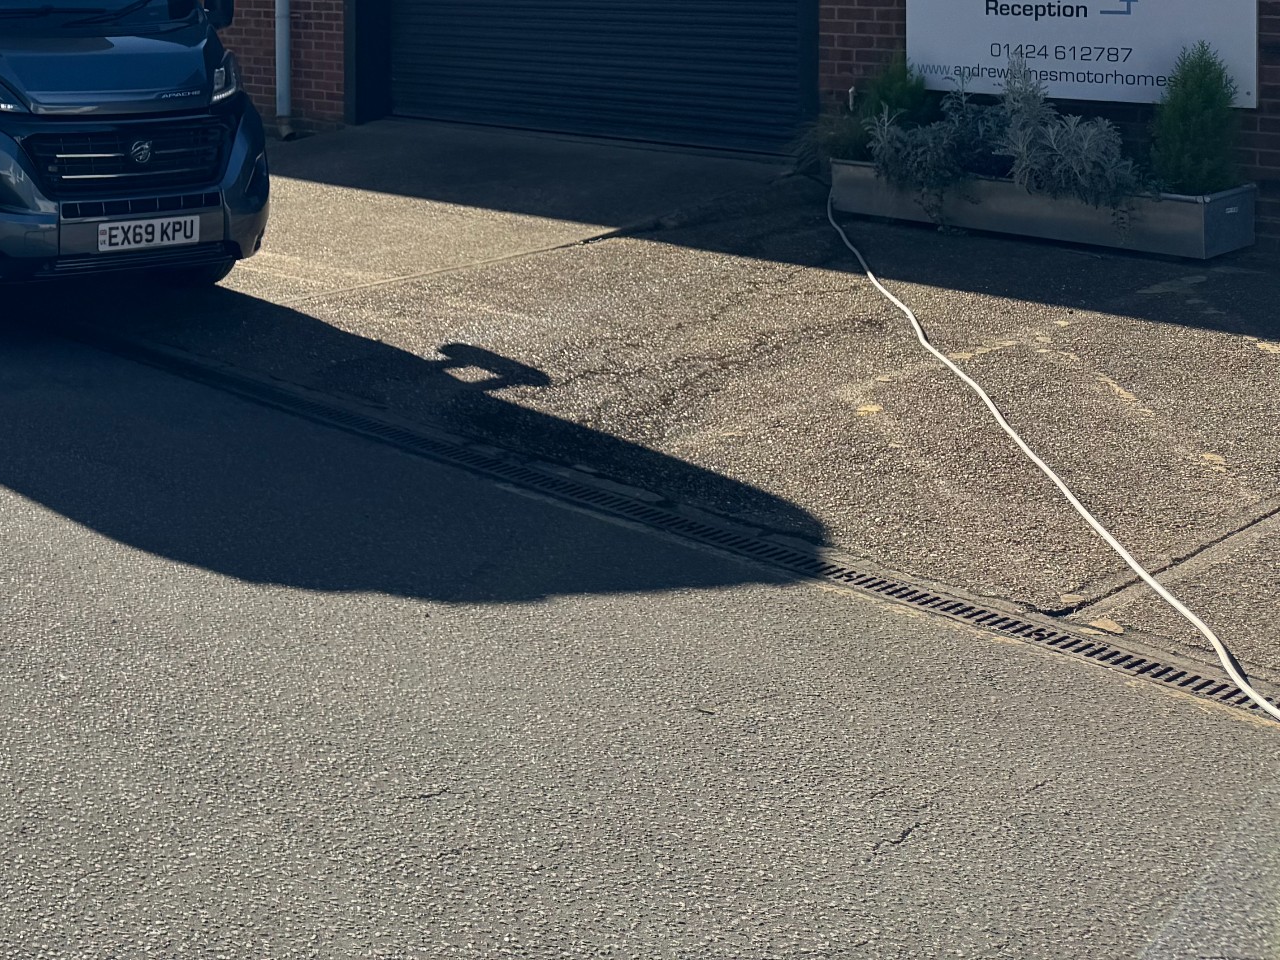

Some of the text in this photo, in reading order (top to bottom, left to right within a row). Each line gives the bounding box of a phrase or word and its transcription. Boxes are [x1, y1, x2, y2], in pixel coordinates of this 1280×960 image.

[990, 43, 1133, 62] 01424 612787
[108, 220, 194, 246] EX69 KPU
